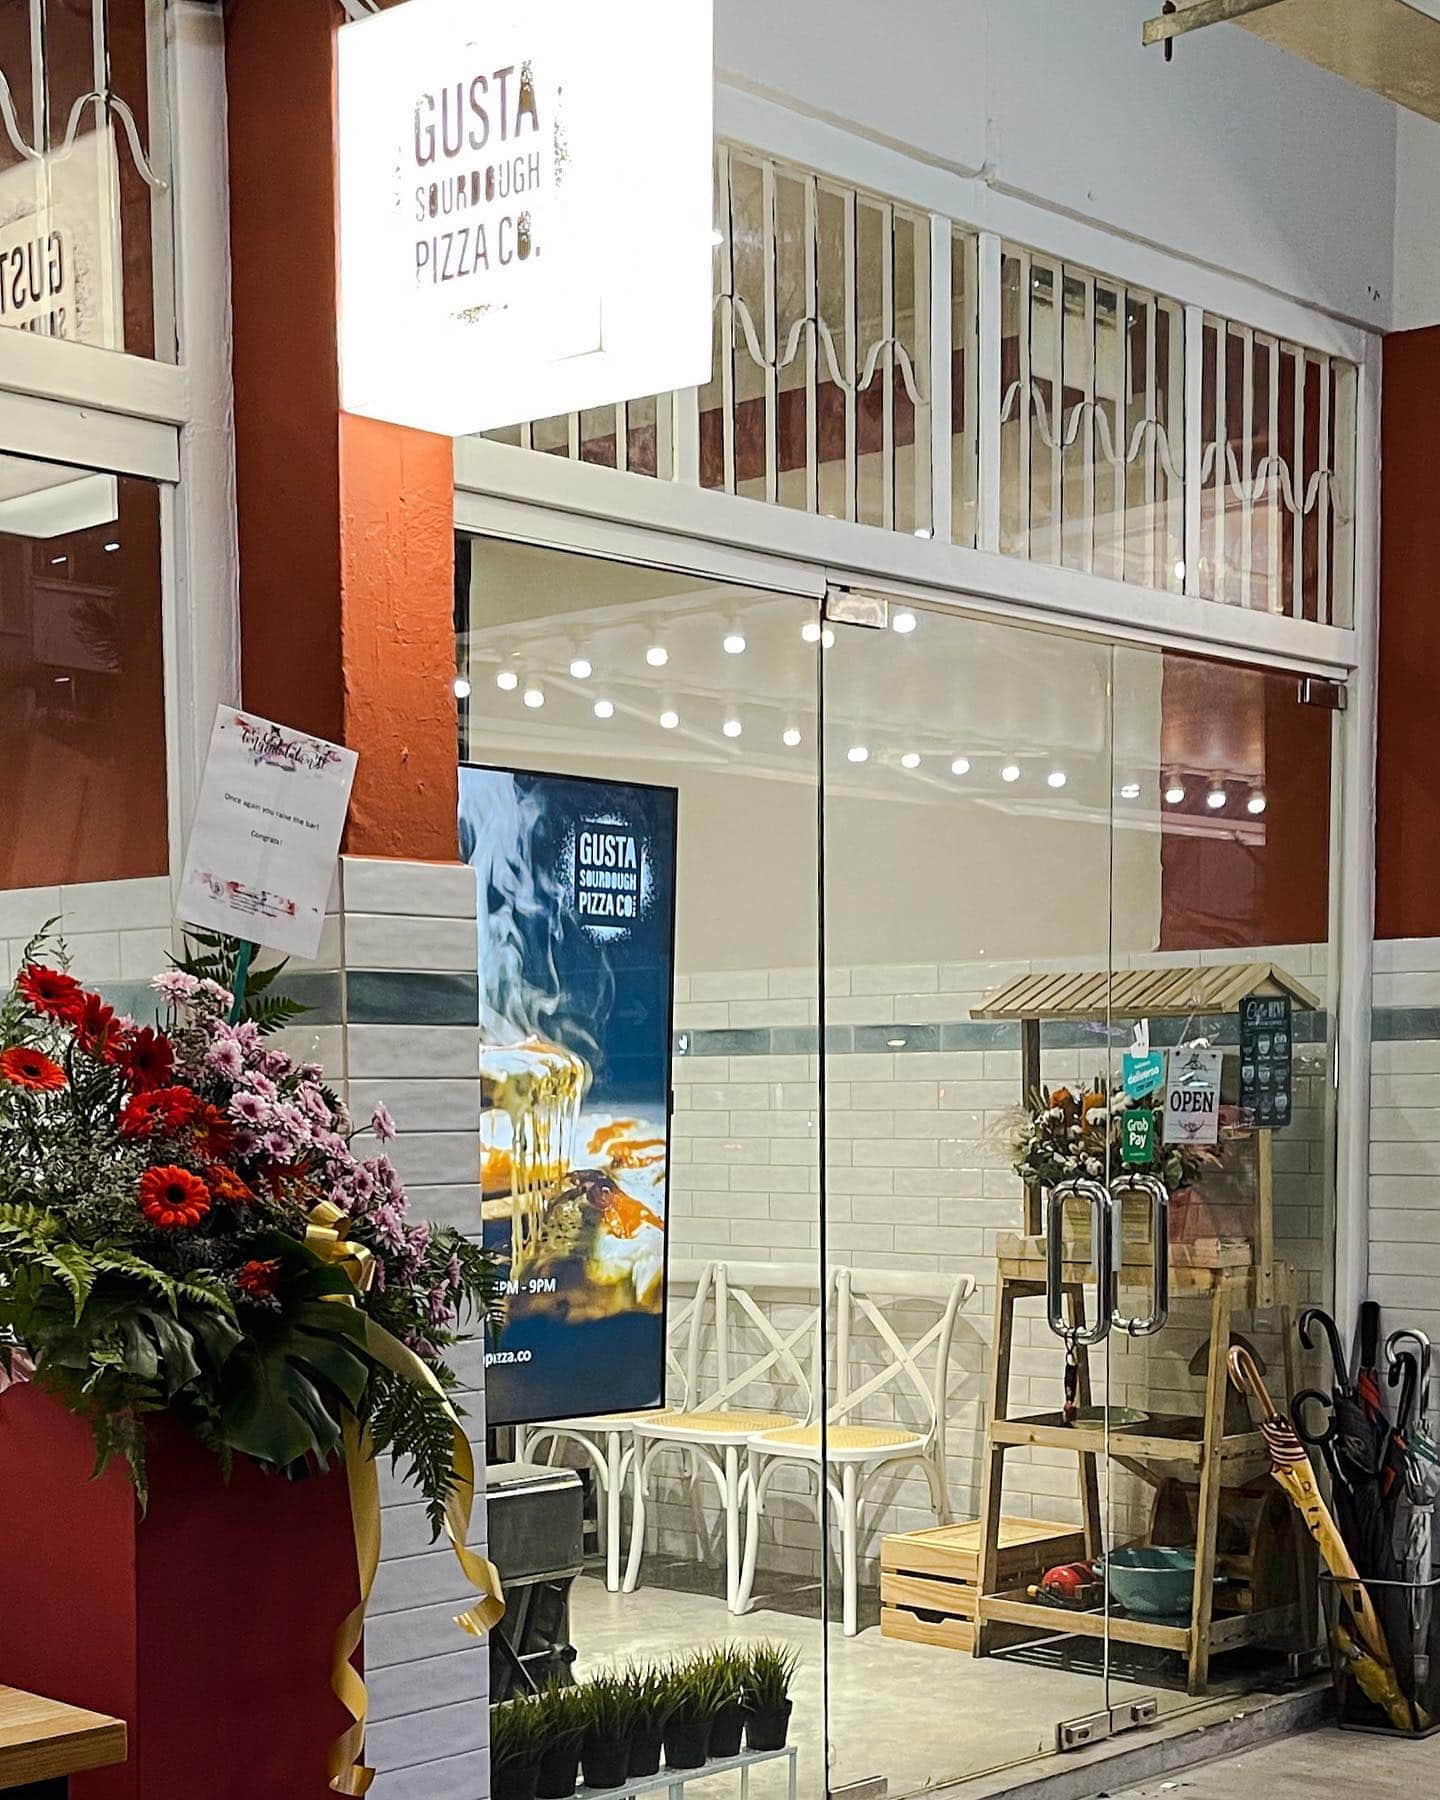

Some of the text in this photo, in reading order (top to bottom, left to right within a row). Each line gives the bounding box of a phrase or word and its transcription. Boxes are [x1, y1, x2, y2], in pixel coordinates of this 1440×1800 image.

[415, 59, 539, 167] GUSTA
[415, 151, 540, 222] SOURDOUGH
[416, 210, 541, 289] PIZZA CO.
[224, 793, 242, 804] Once
[243, 801, 261, 810] again
[262, 807, 275, 817] you
[292, 816, 304, 826] the
[580, 832, 637, 869] GUSTA
[580, 869, 637, 891] SOURDOUGH
[579, 891, 614, 917] PIZZA
[1170, 1090, 1215, 1113] OPEN
[1127, 1117, 1149, 1132] Grab
[1129, 1132, 1147, 1148] Pay
[528, 1277, 557, 1294] 9PM
[483, 1349, 532, 1368] pizza.co
